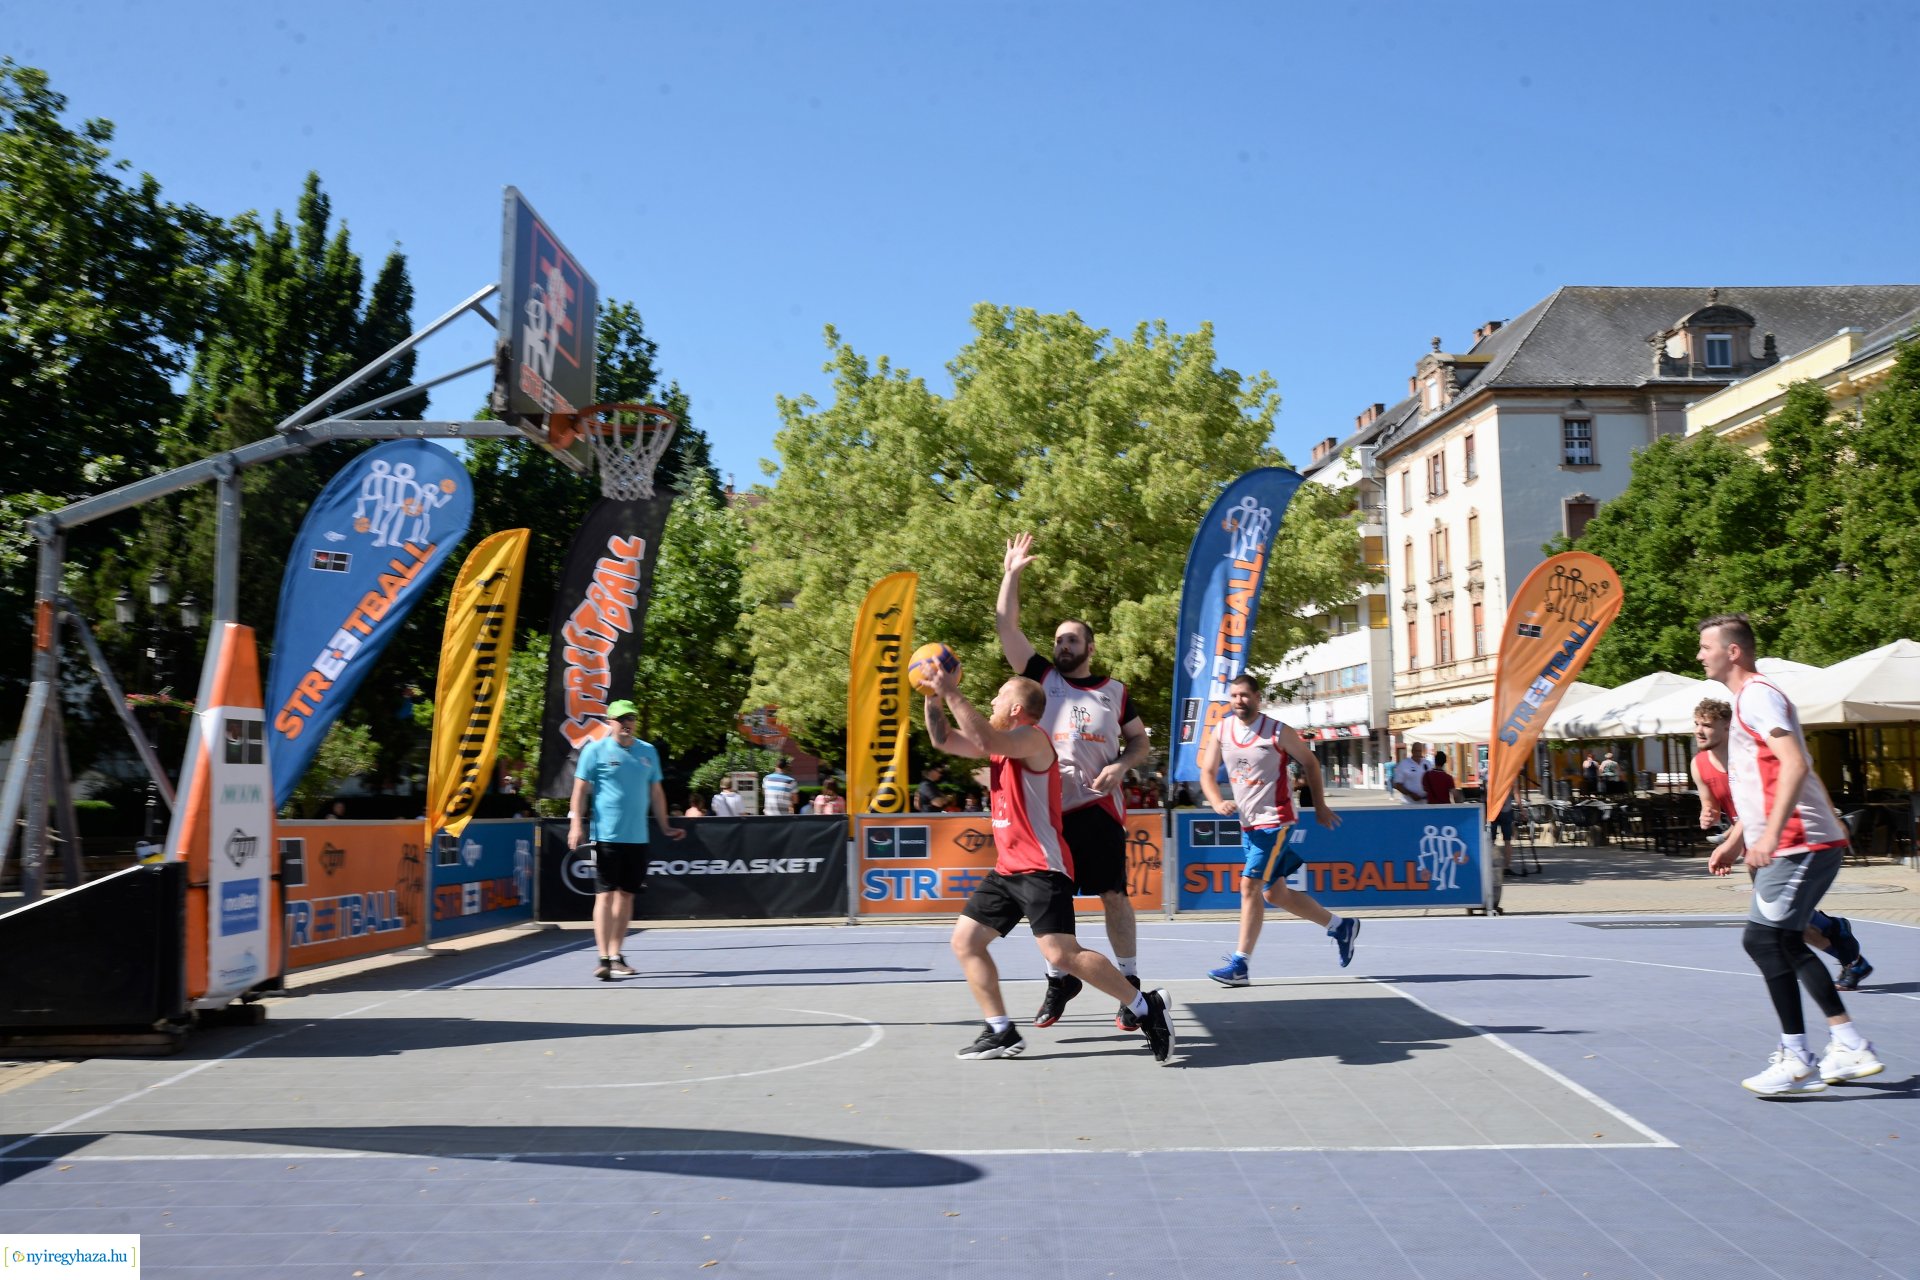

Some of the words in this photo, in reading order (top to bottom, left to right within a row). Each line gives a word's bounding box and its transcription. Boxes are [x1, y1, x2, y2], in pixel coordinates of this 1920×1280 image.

[274, 540, 437, 741] STREETBALL
[559, 534, 647, 750] STREETBALL
[1196, 550, 1266, 769] REETBALL
[1500, 619, 1600, 746] STREETBALL
[285, 890, 404, 948] TREETBALL
[646, 857, 825, 876] ROSBASKET
[1183, 862, 1430, 893] STETBALL
